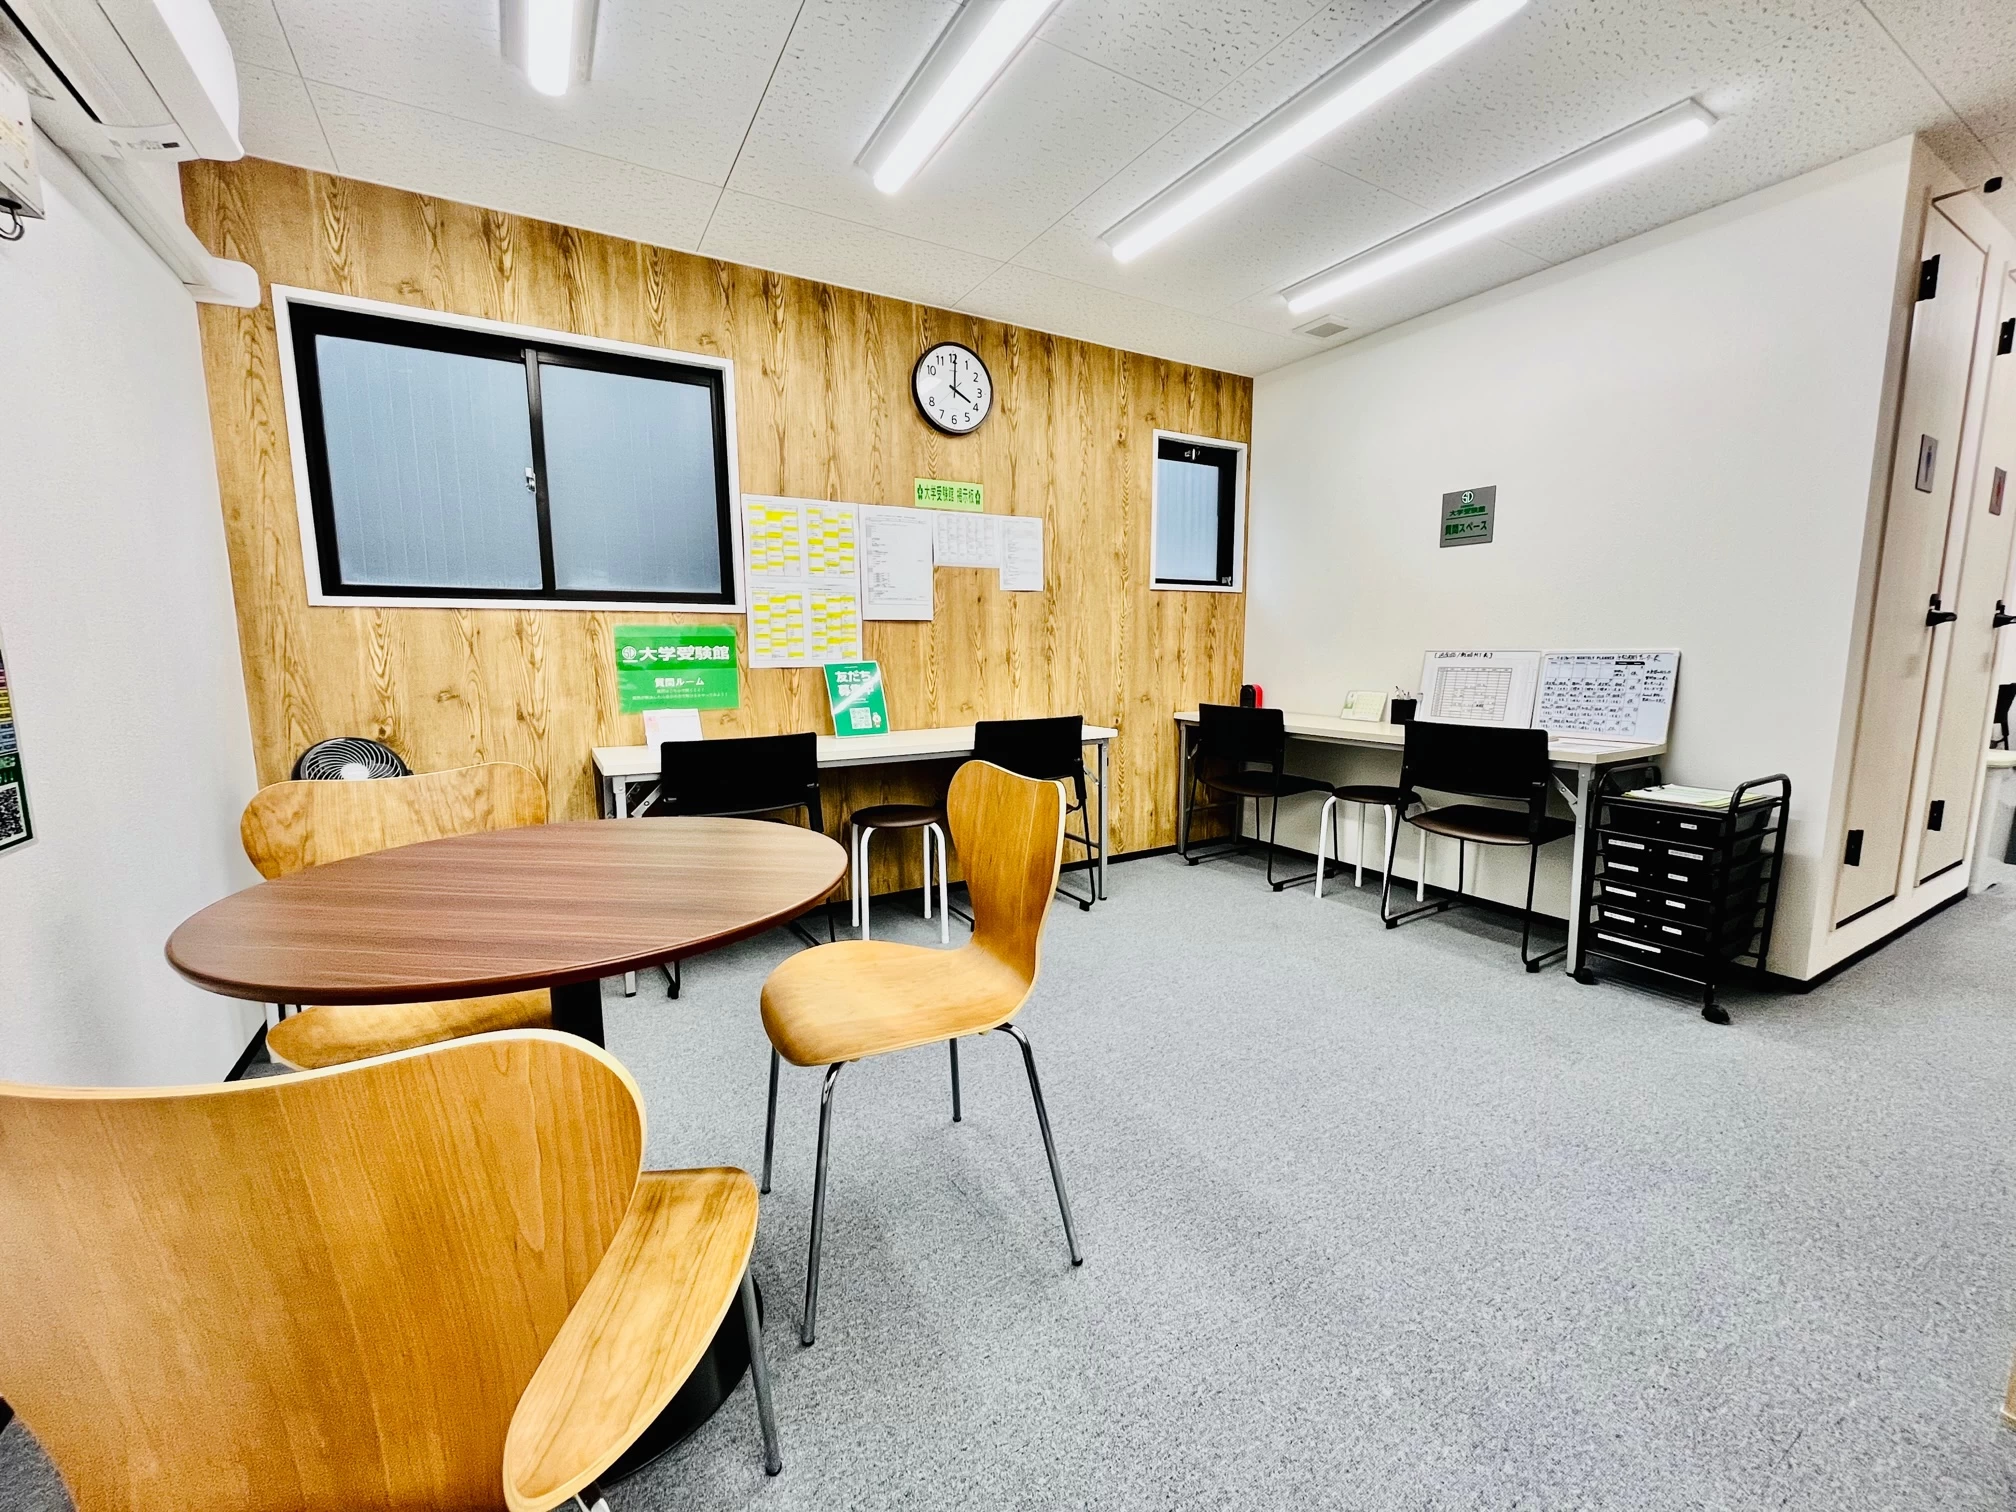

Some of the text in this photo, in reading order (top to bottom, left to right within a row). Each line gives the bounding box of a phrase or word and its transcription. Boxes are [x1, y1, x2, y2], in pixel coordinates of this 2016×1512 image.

[936, 355, 944, 366] 11
[949, 353, 957, 364] 12
[927, 364, 936, 376] 10
[965, 360, 969, 370] 1
[973, 372, 979, 383] 2
[977, 388, 982, 398] 3
[929, 396, 935, 407] 8
[973, 403, 979, 412] 4
[939, 409, 945, 419] 7
[964, 412, 970, 422] 5
[951, 415, 957, 425] 6
[1444, 520, 1488, 536] 質問スペース
[638, 645, 730, 661] 大学受験館
[834, 670, 871, 683] 友だち
[654, 677, 705, 688] 質問ルーム
